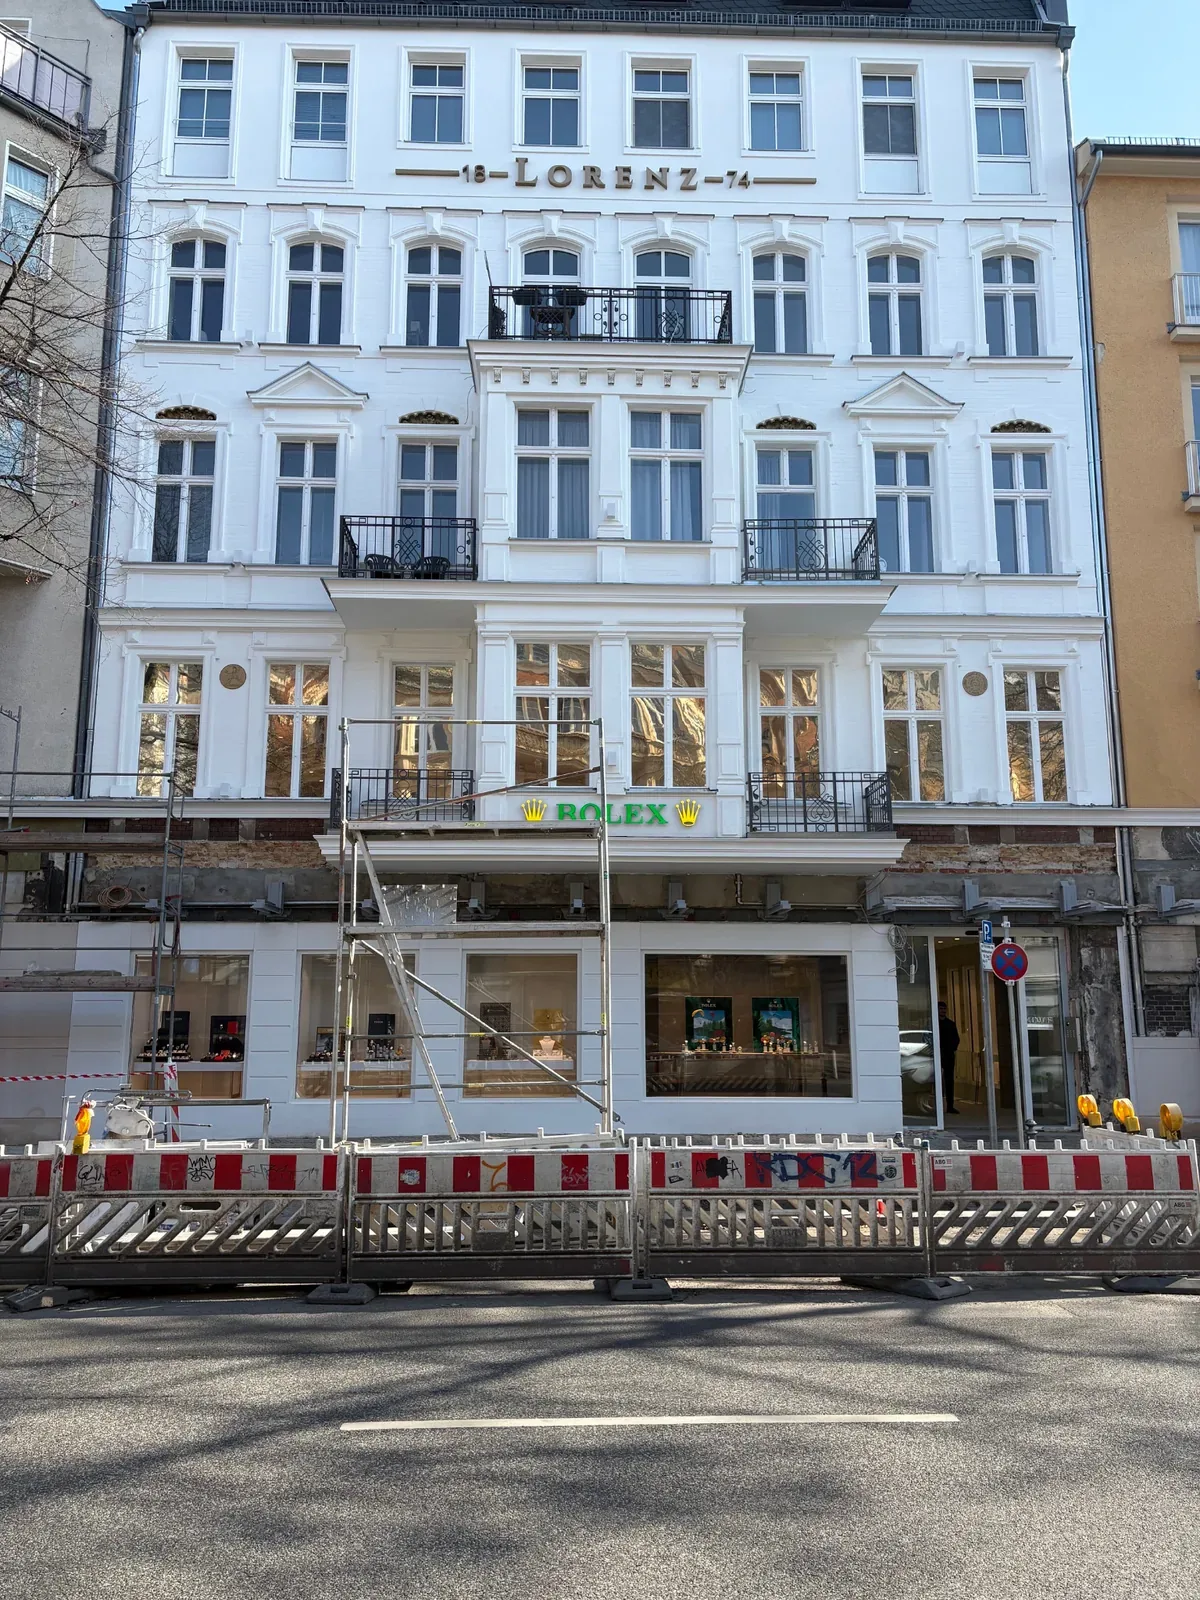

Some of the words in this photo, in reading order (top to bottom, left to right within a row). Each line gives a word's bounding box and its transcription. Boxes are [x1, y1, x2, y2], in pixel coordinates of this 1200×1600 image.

[462, 164, 486, 183] 18
[515, 157, 699, 190] LORENZ
[726, 170, 751, 189] 74
[556, 802, 669, 825] ROLEX
